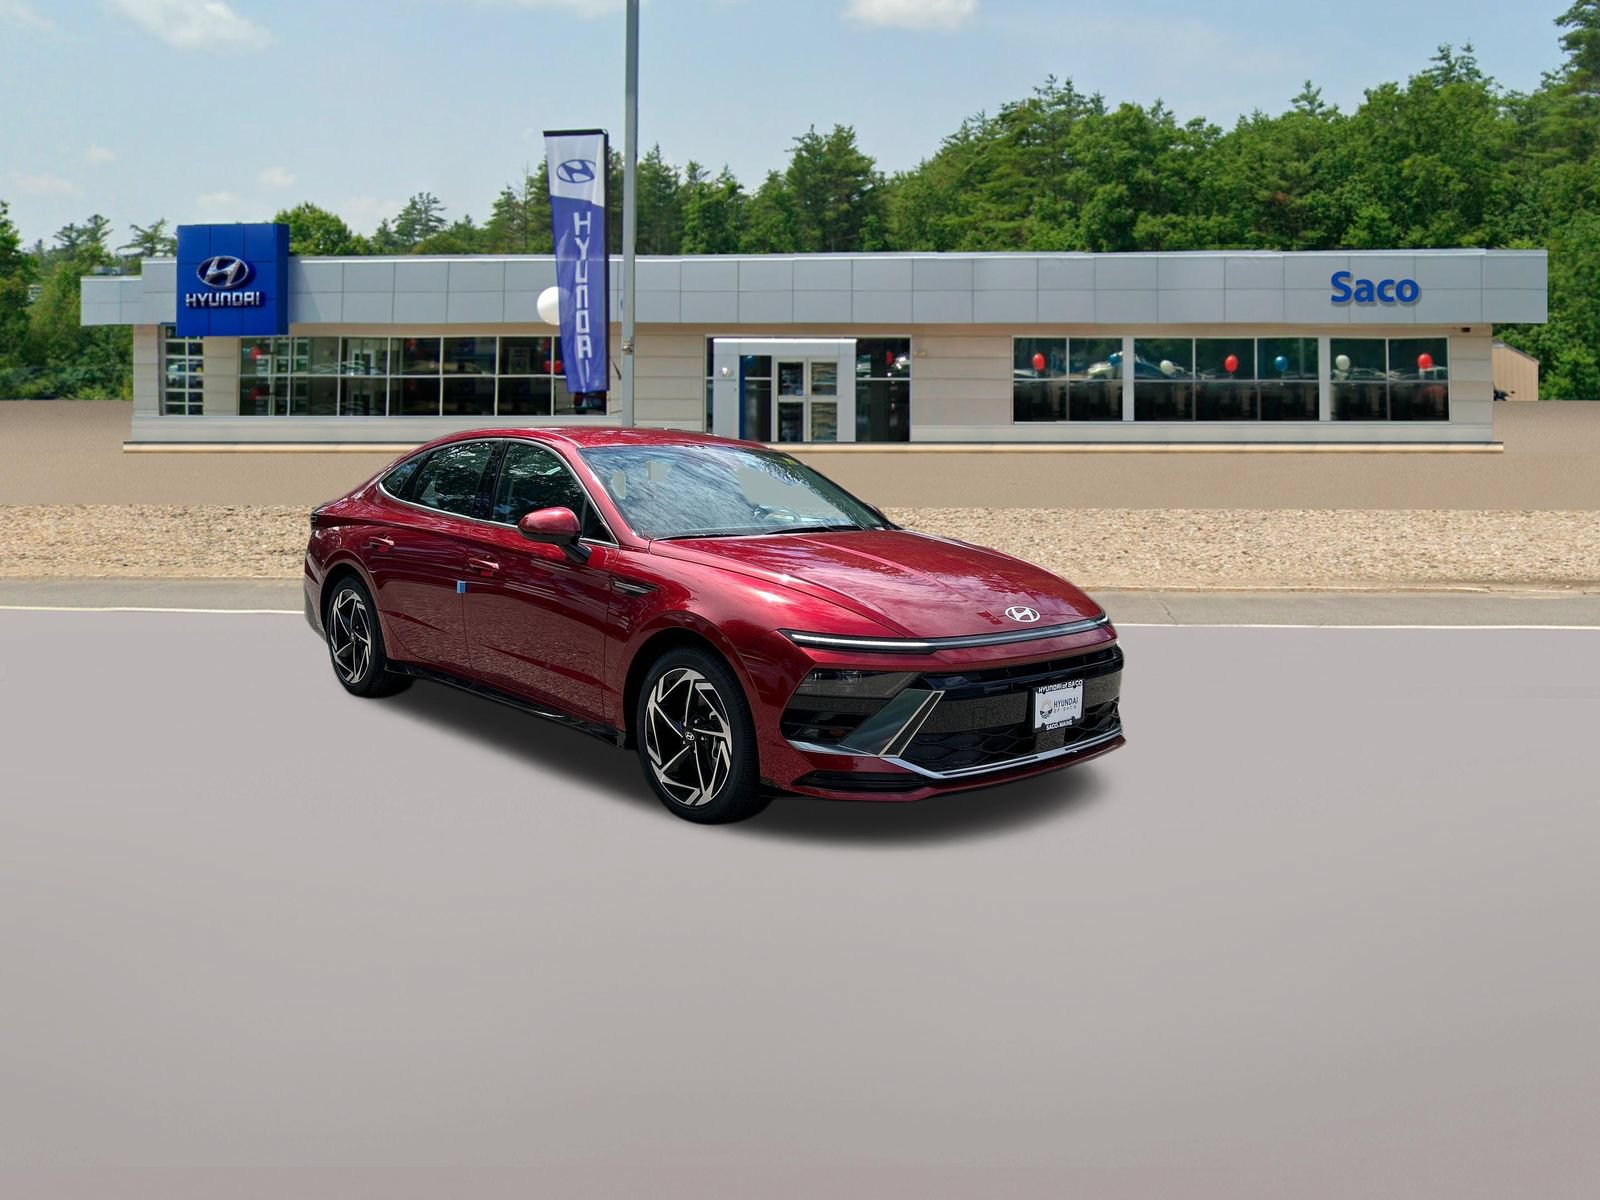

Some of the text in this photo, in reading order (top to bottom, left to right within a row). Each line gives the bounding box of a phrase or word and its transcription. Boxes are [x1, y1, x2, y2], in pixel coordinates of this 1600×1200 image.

[1331, 270, 1420, 303] Saco
[185, 292, 261, 308] HYUNDAI
[573, 211, 591, 383] HYUNDAI
[1038, 683, 1062, 693] HYUNDAI
[1068, 679, 1083, 688] SACO
[1053, 697, 1079, 708] HYUNDAI
